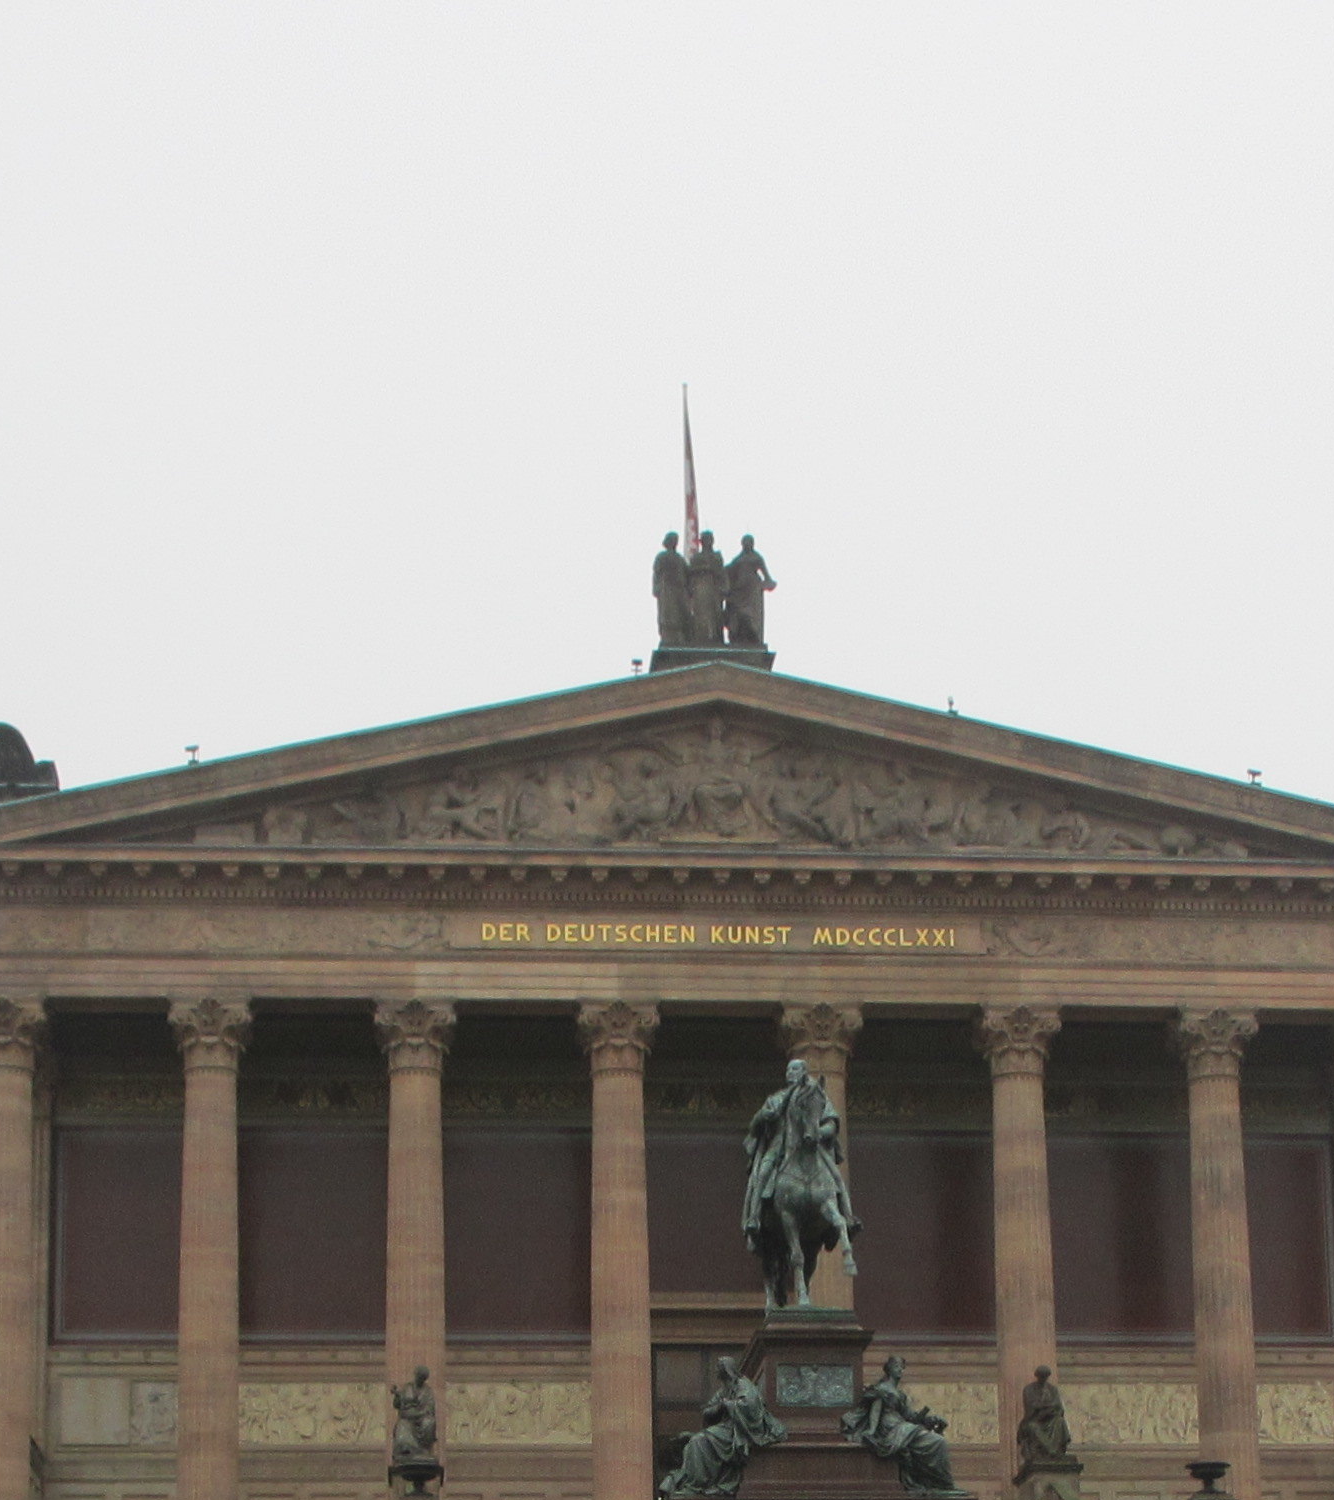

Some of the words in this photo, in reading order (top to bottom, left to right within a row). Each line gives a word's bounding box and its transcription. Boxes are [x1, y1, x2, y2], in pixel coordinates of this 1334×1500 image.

[480, 922, 533, 942] DER
[546, 922, 696, 945] DEUTSCHEN
[710, 925, 793, 945] KUNST
[812, 927, 955, 947] MDCCCLXXI
